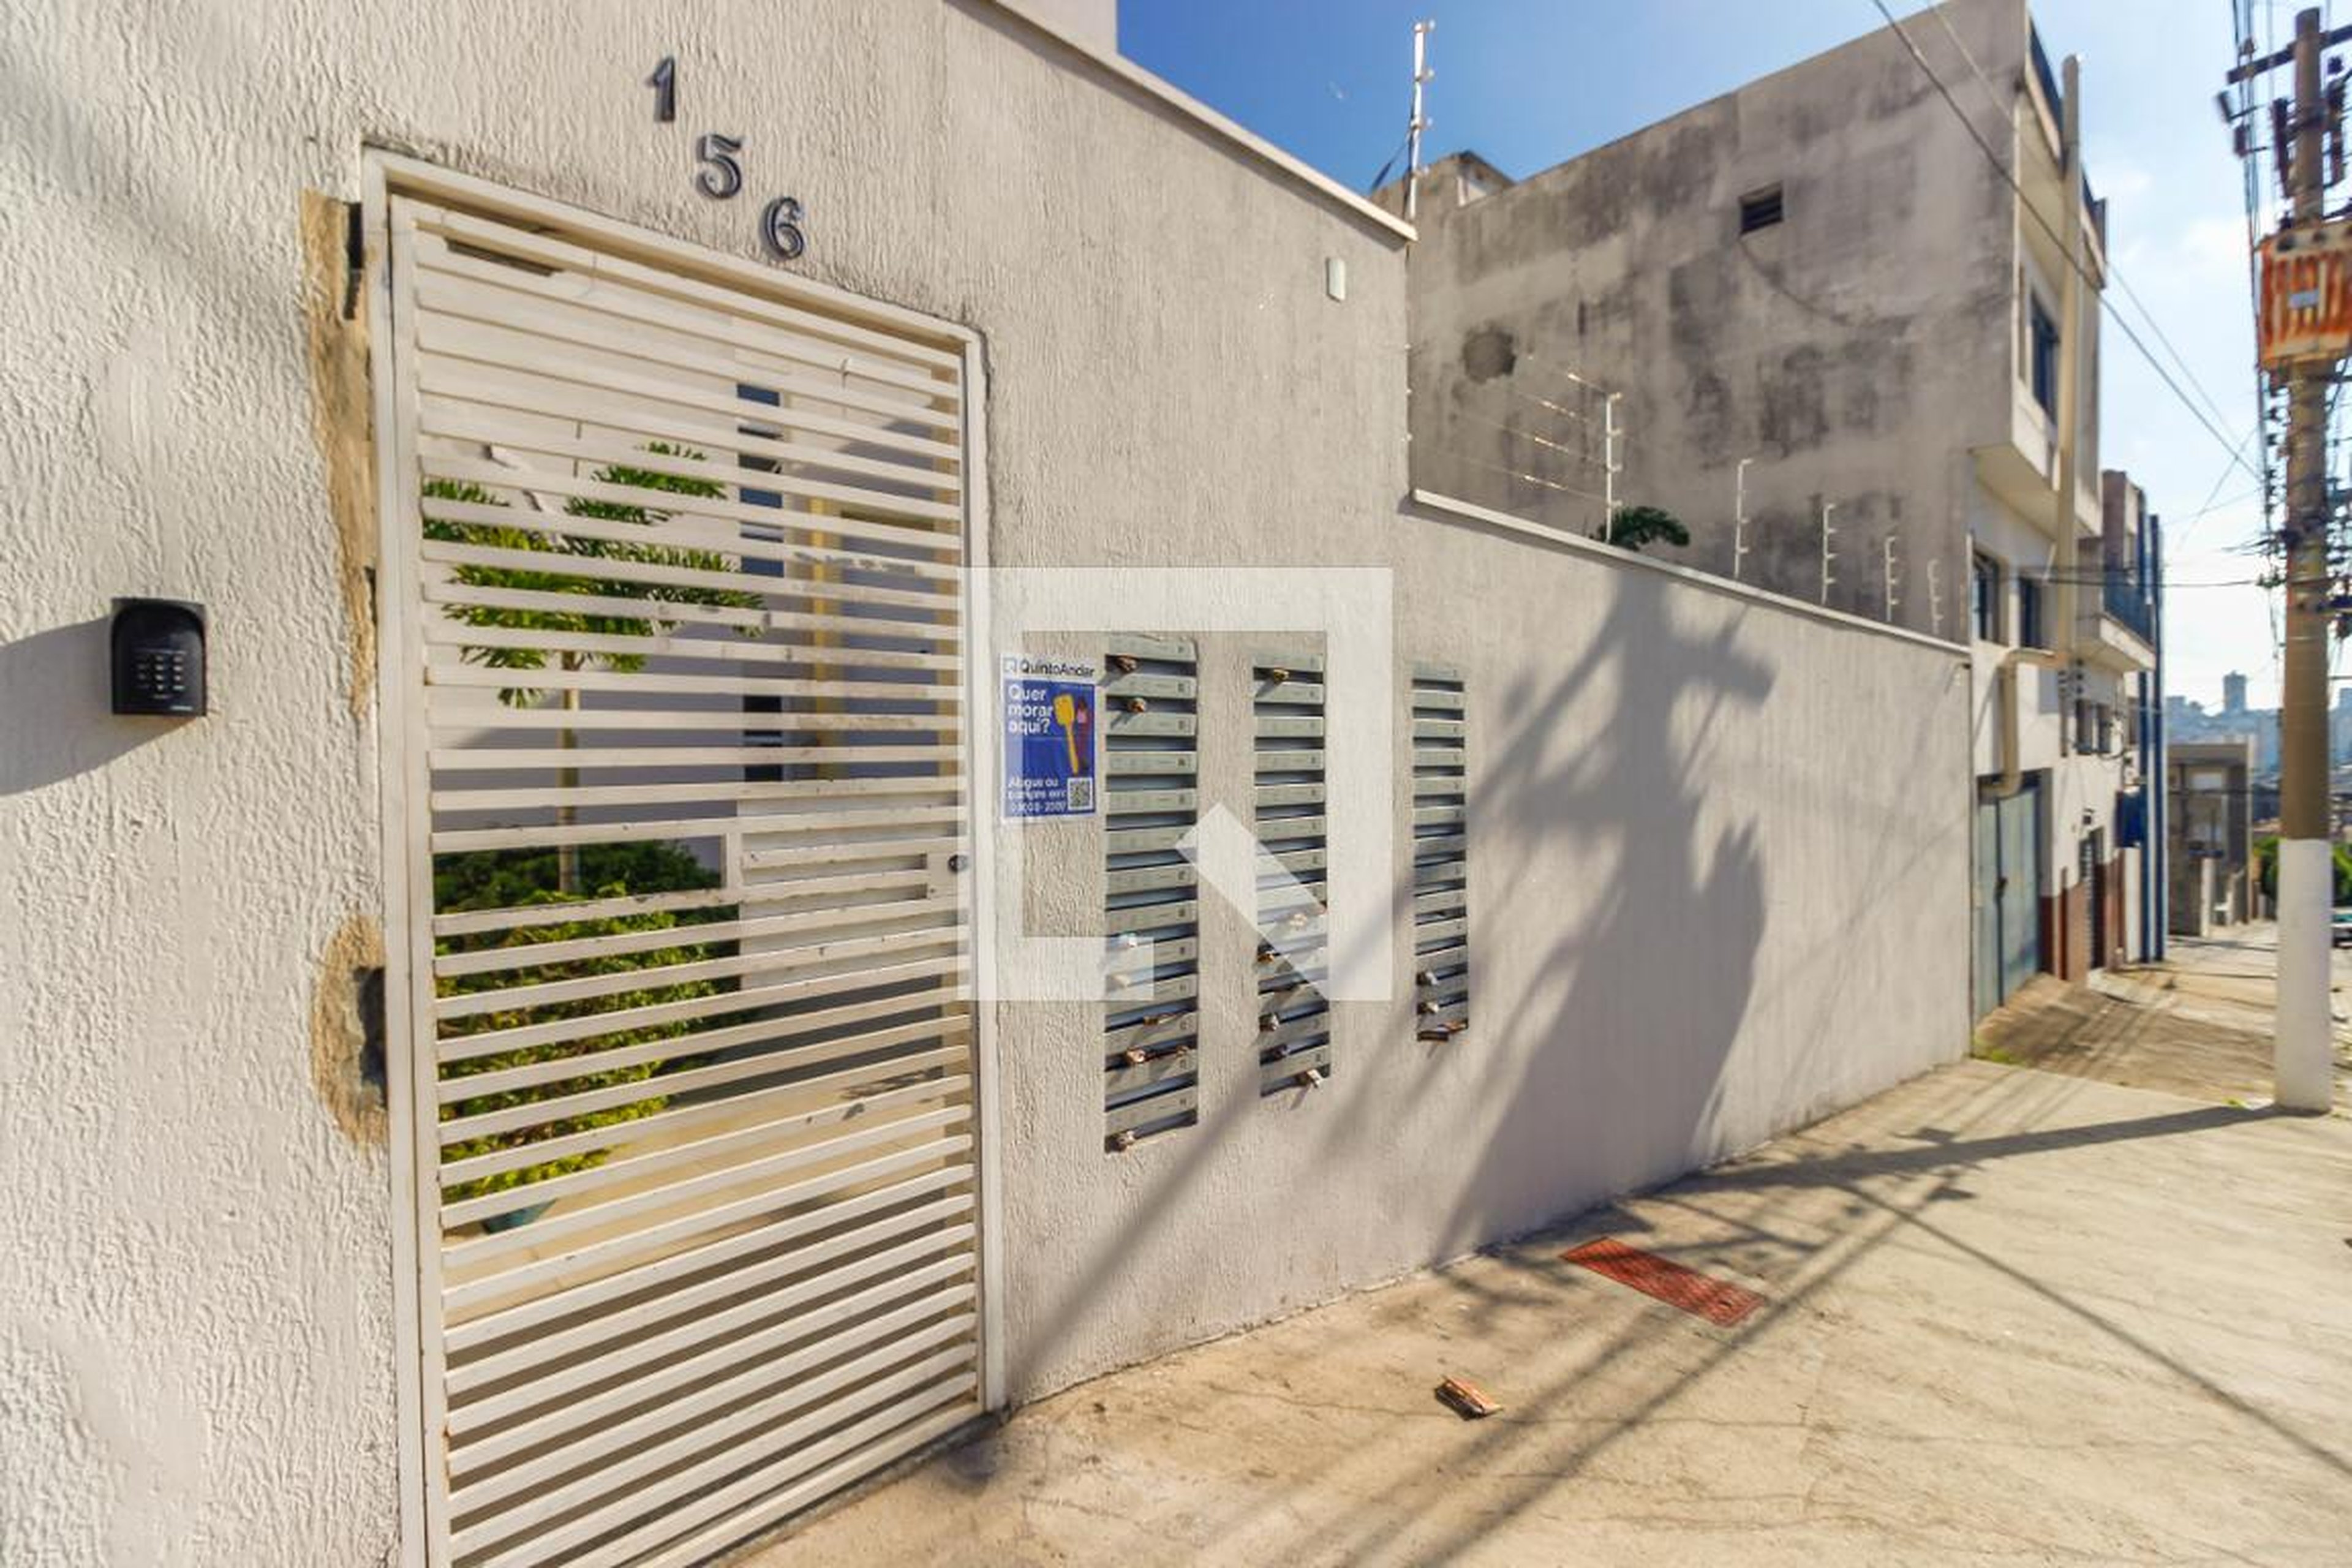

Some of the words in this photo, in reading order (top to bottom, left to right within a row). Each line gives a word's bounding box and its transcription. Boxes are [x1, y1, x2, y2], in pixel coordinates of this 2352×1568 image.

[646, 55, 805, 260] 156
[1020, 659, 1095, 676] QuintoAndar
[1008, 684, 1047, 701] Quer
[1008, 704, 1054, 717] morar
[1008, 718, 1050, 736] aqui?
